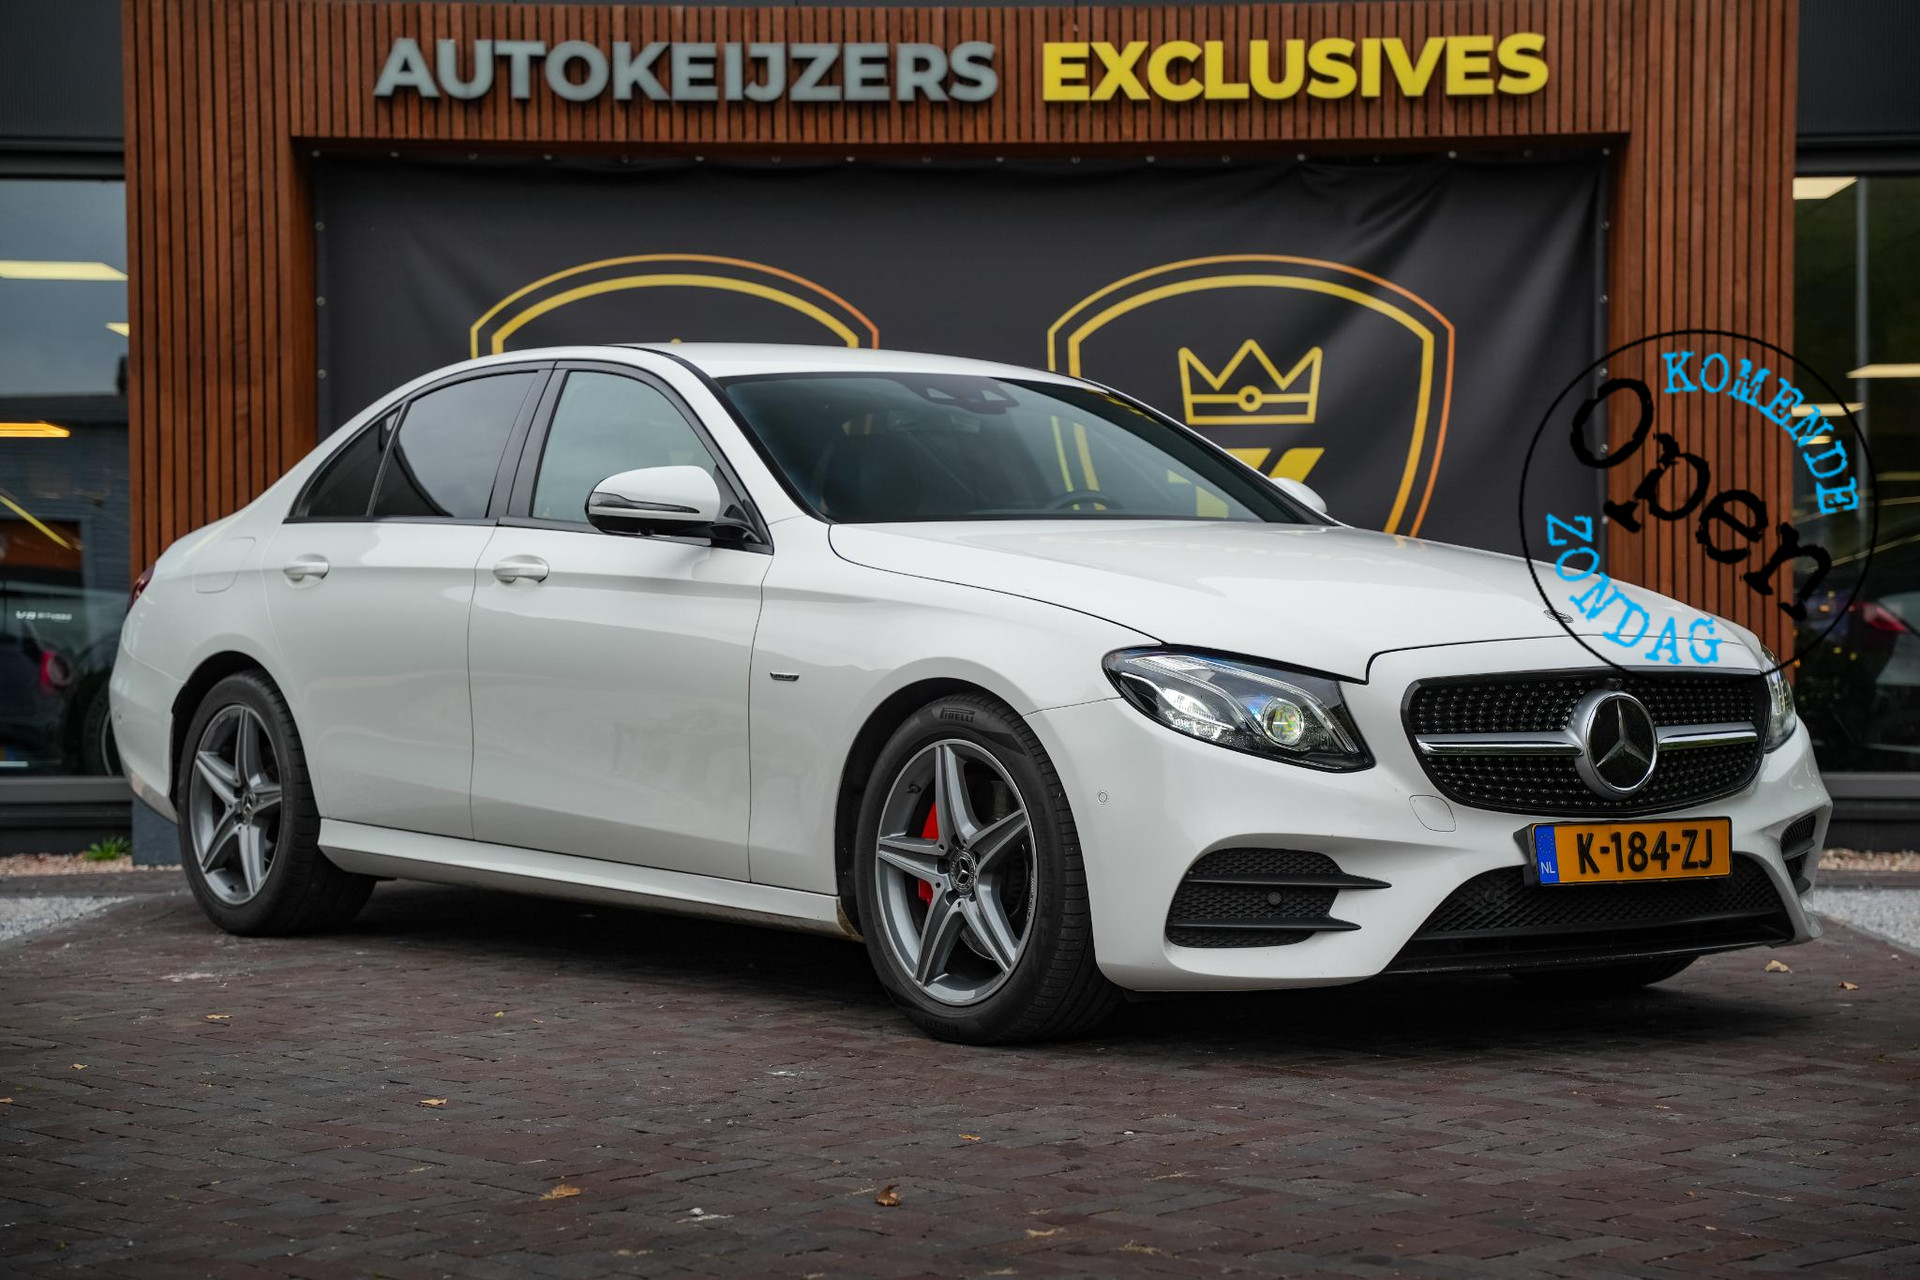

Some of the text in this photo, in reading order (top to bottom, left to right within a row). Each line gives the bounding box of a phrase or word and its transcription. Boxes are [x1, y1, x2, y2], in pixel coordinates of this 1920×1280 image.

[373, 32, 1549, 102] AUTOKEIJZERS EXCLUSIVES
[940, 707, 976, 722] PIRELLI
[1540, 828, 1713, 875] NL K-184-ZJ
